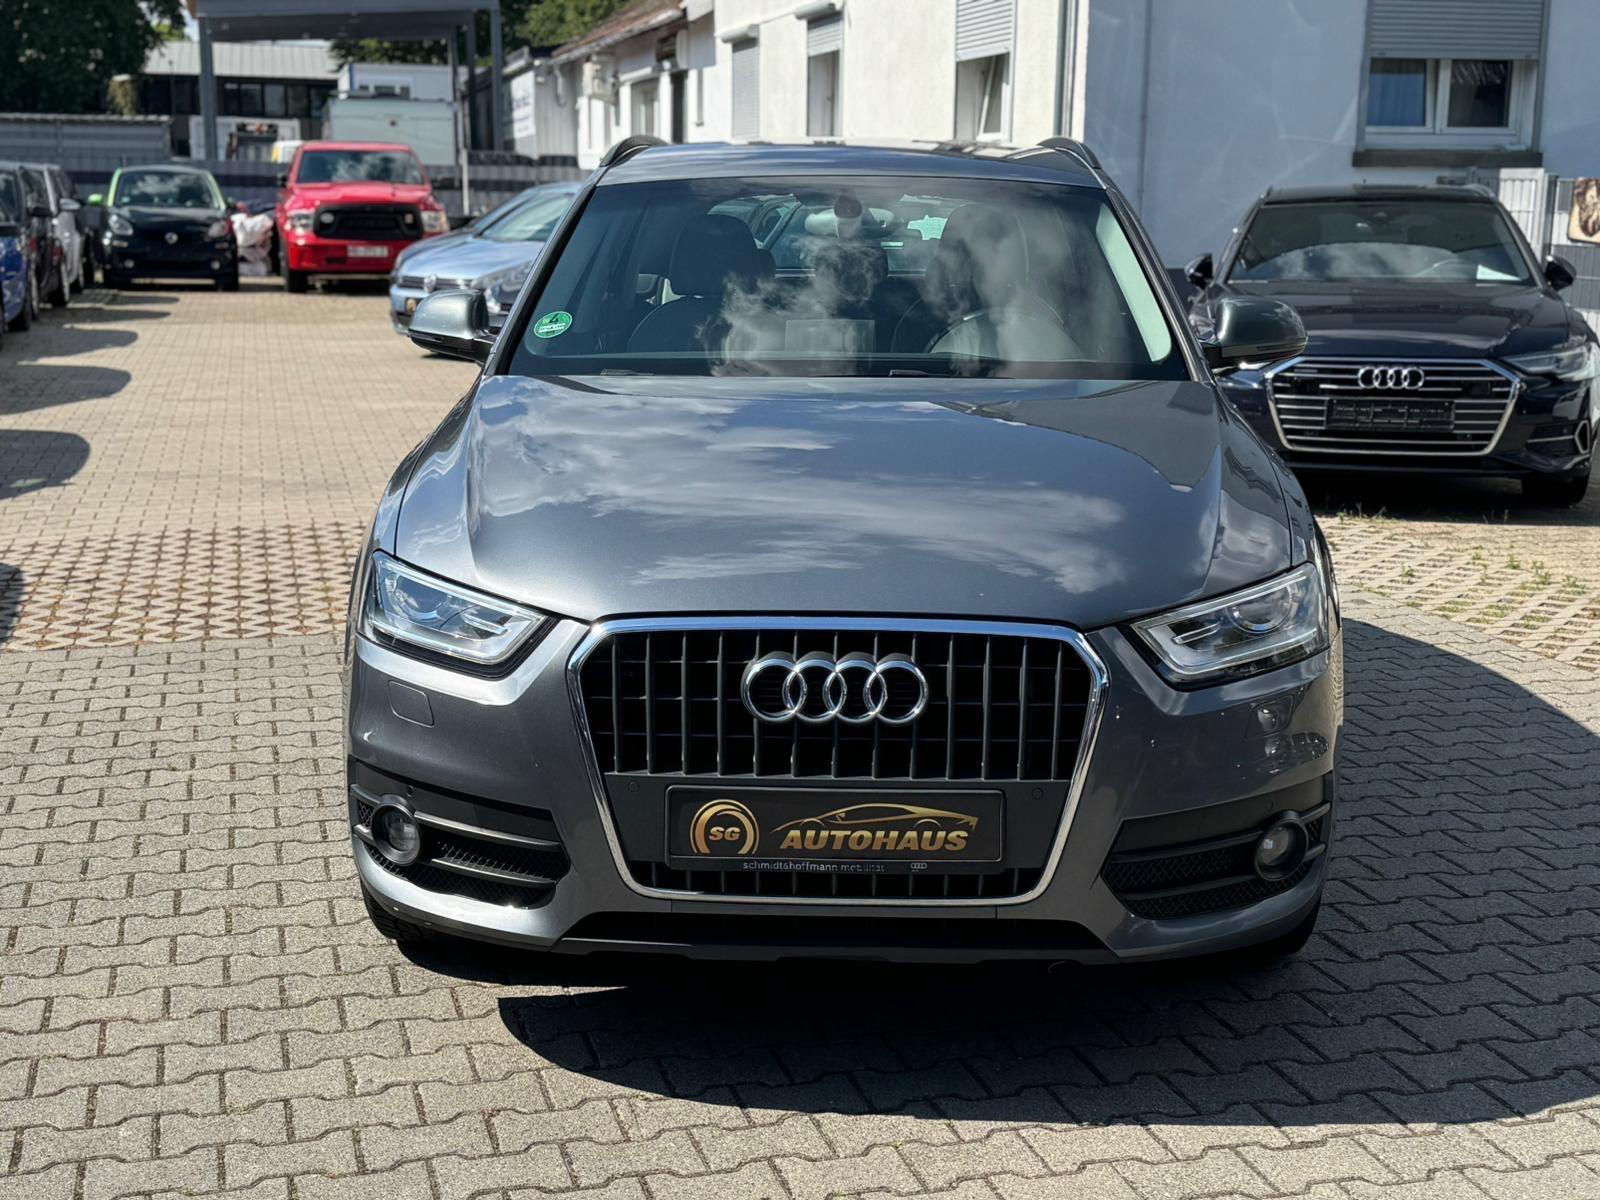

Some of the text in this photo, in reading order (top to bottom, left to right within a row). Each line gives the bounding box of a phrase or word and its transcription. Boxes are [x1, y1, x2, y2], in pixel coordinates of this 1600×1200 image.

[549, 313, 559, 324] 4
[708, 826, 741, 841] SG
[779, 829, 969, 851] AUTOHAUS
